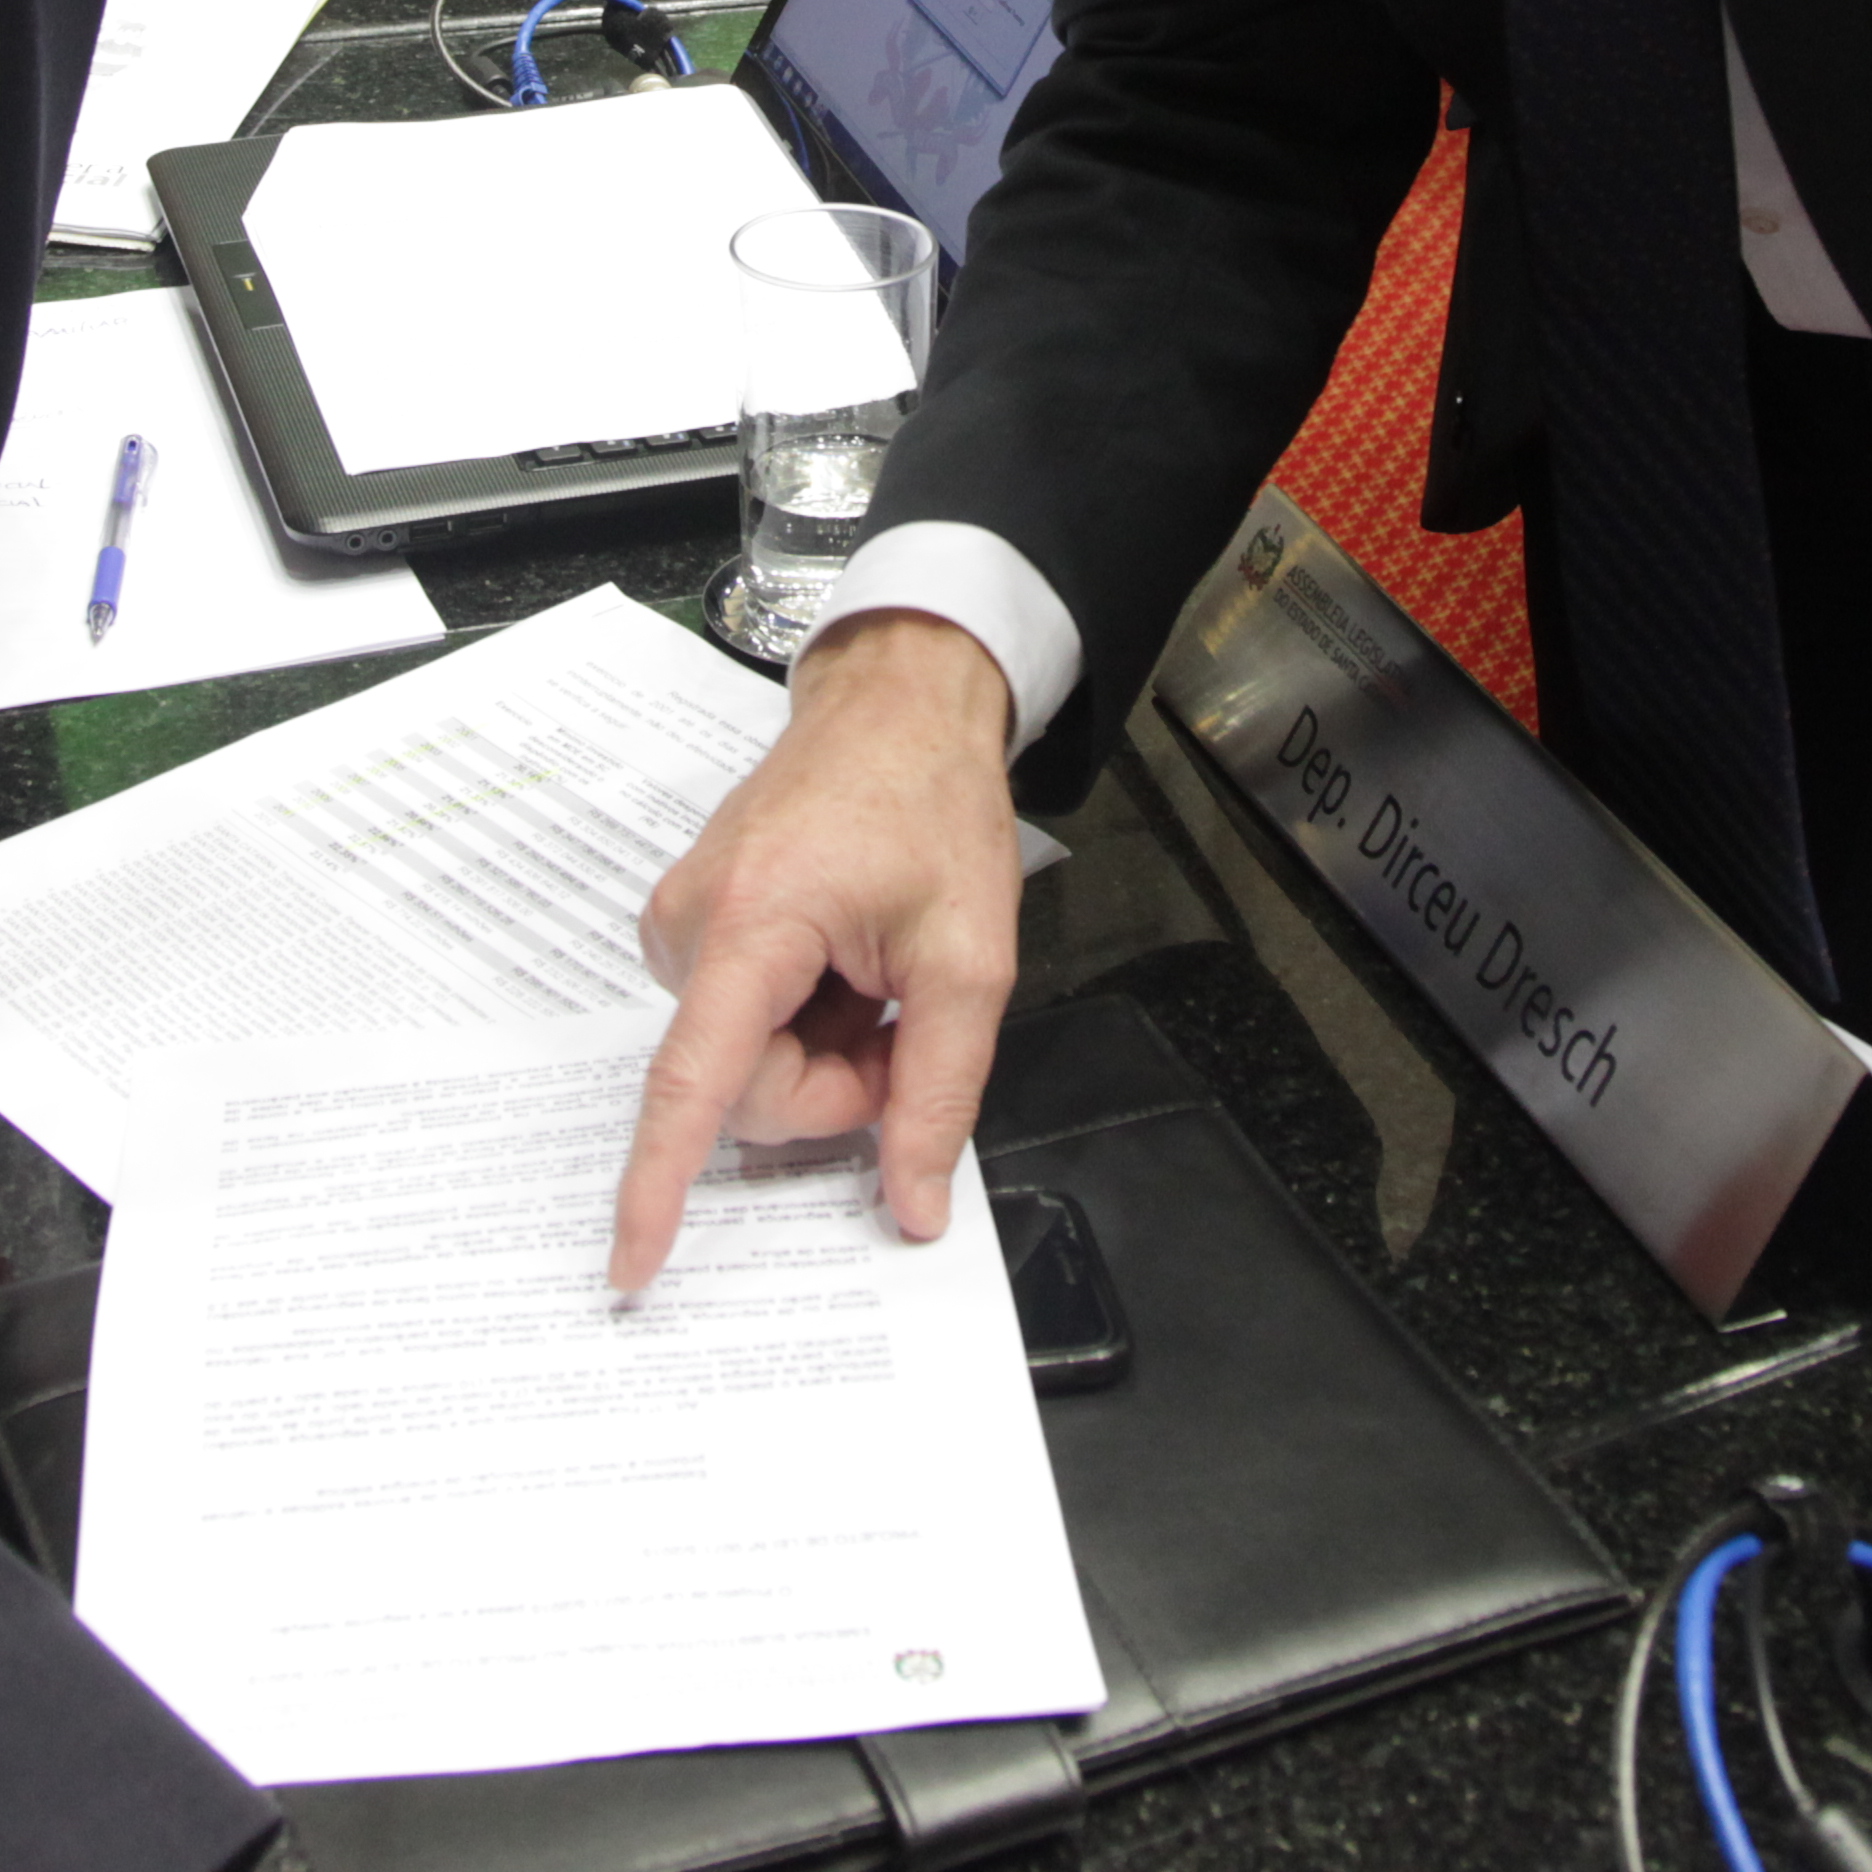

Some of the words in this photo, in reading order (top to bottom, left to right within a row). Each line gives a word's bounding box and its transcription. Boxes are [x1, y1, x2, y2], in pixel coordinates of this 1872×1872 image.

[1273, 587, 1291, 609] DO
[1286, 601, 1322, 641] ESTADO
[1317, 634, 1334, 655] DE
[1330, 646, 1361, 682] SANTA
[1286, 565, 1351, 635] ASSEMBLEIA
[1276, 704, 1353, 830] Dep.
[1357, 793, 1480, 955] Dirceu
[1475, 920, 1618, 1109] Dresch
